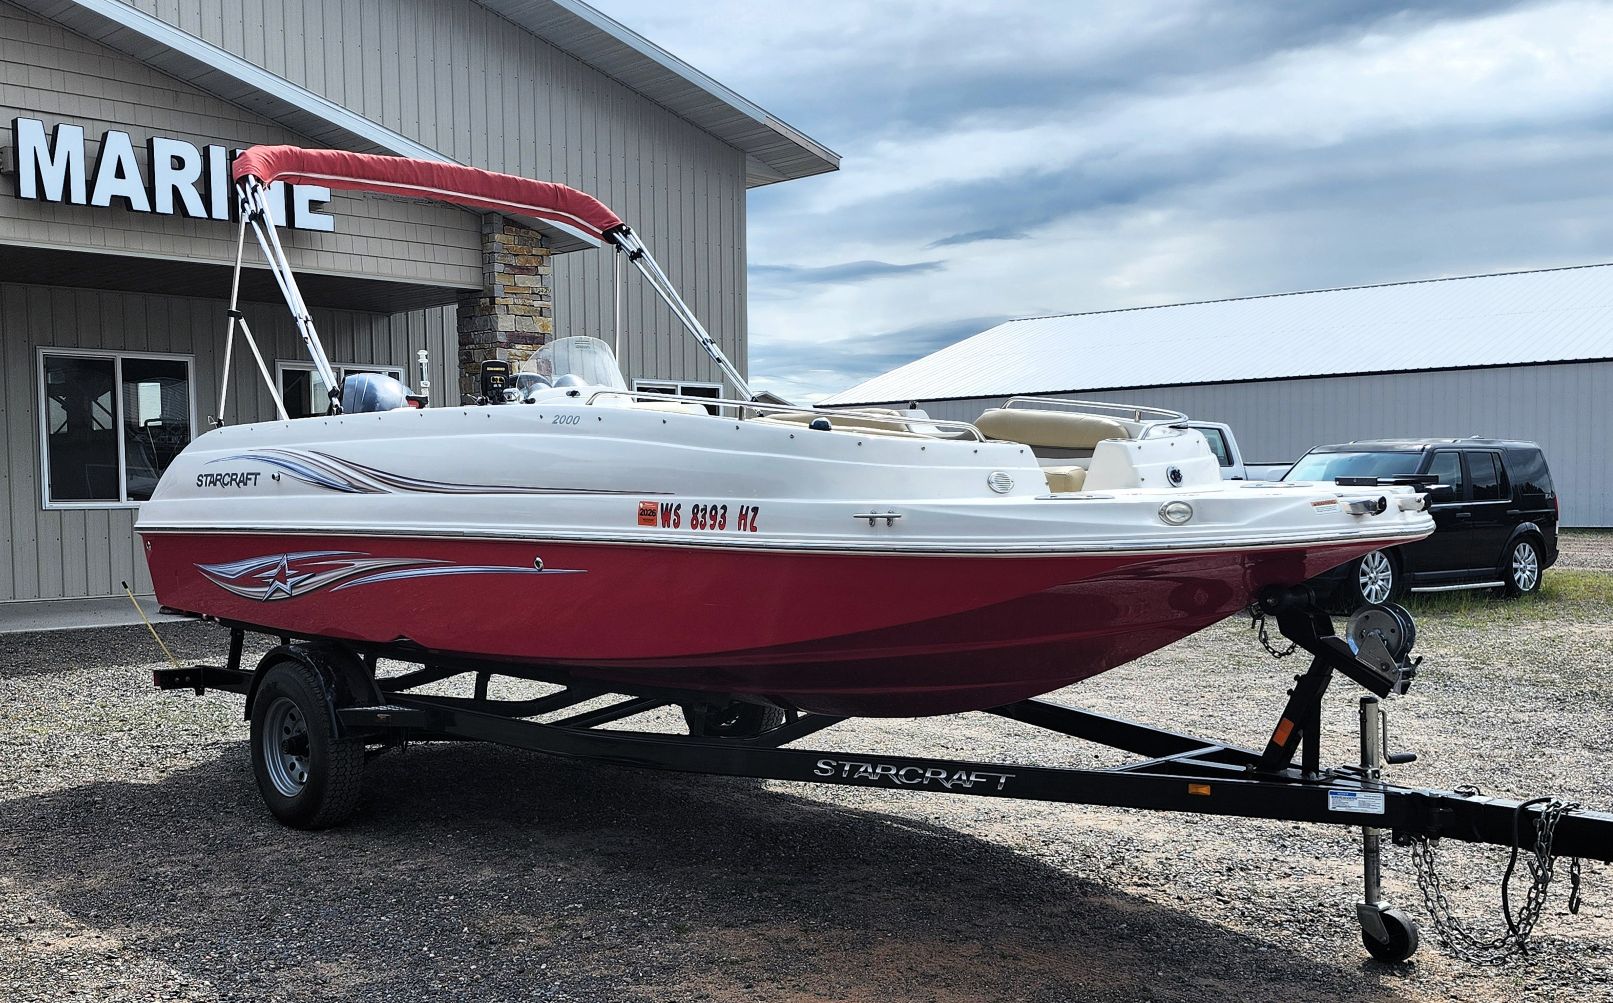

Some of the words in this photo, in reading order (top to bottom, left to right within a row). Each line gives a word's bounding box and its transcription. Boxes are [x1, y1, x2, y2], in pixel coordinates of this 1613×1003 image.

[551, 414, 581, 425] 2000
[196, 472, 261, 488] STARCRAFT
[639, 508, 657, 517] 2026
[660, 502, 682, 529] WS
[690, 503, 728, 531] 8393
[737, 504, 759, 533] HZ
[813, 759, 1017, 790] STARCRAFT
